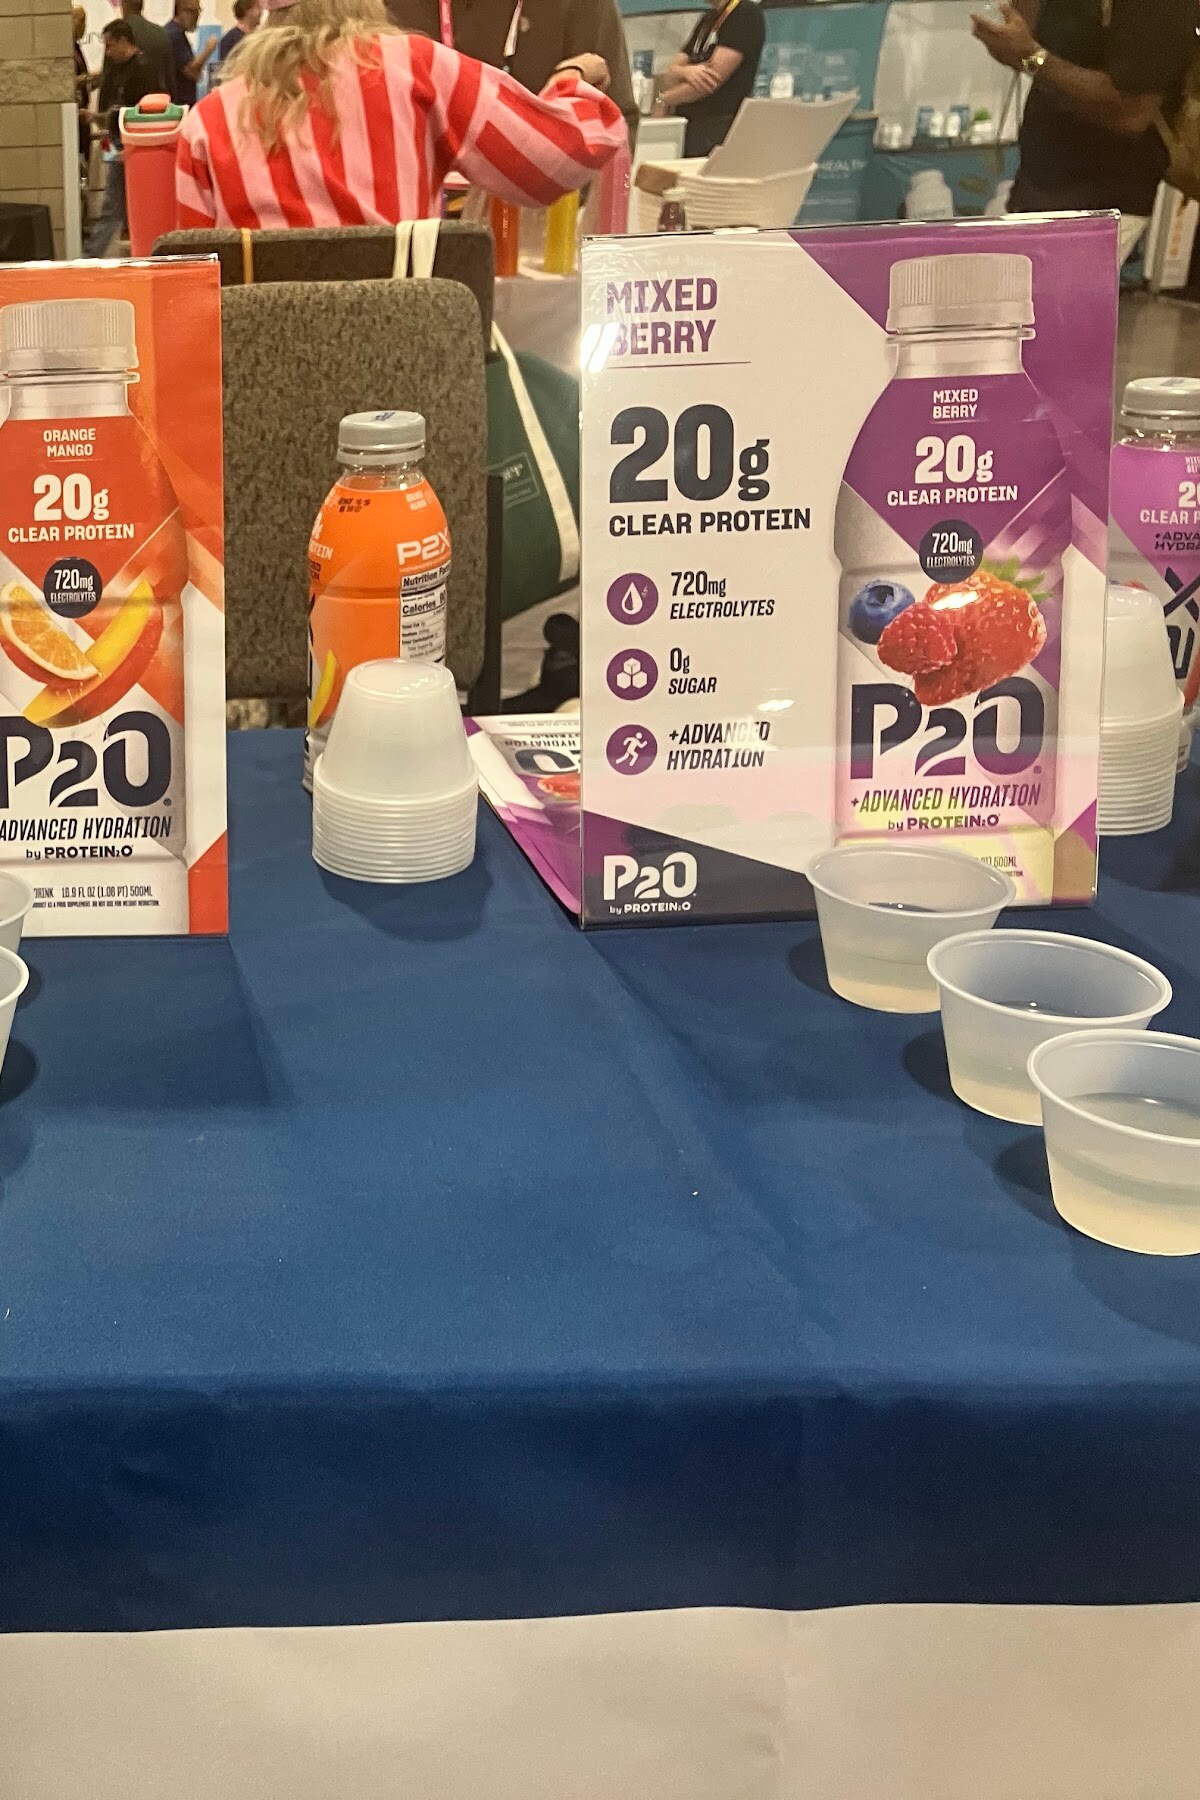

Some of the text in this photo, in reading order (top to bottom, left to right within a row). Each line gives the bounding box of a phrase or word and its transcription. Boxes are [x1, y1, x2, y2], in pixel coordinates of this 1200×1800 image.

[607, 277, 718, 314] MIXED
[606, 319, 716, 356] BERRY
[933, 388, 979, 403] MIXED
[933, 404, 977, 419] BERRY
[43, 428, 96, 442] ORANGE
[46, 443, 93, 457] MANGO
[609, 404, 770, 503] 20g
[914, 434, 993, 484] 20g
[33, 472, 109, 521] 20g
[887, 485, 1018, 506] CLEAR PROTEIN
[1179, 481, 1200, 508] 2
[609, 508, 811, 537] CLEAR PROTEIN
[1140, 509, 1189, 524] CLEAR
[8, 523, 135, 543] CLEAR PROTEIN
[931, 531, 973, 555] 720mg
[927, 555, 976, 568] ELECTROLYTES
[54, 568, 94, 591] 720mg
[403, 570, 438, 588] Nutrition
[670, 571, 726, 597] 720mg
[50, 591, 96, 604] ELECTROLYTES
[402, 601, 437, 615] Calories
[670, 599, 775, 620] ELECTROLYTES
[670, 647, 690, 674] 0g
[668, 677, 717, 695] SUGAR
[666, 748, 765, 771] HYDRATION
[851, 784, 1041, 813] +ADVANCED HYDRATION
[82, 815, 172, 838] HYDRATION
[888, 819, 904, 831] by
[25, 848, 41, 860] by
[130, 885, 153, 897] 500ML
[609, 905, 621, 914] by
